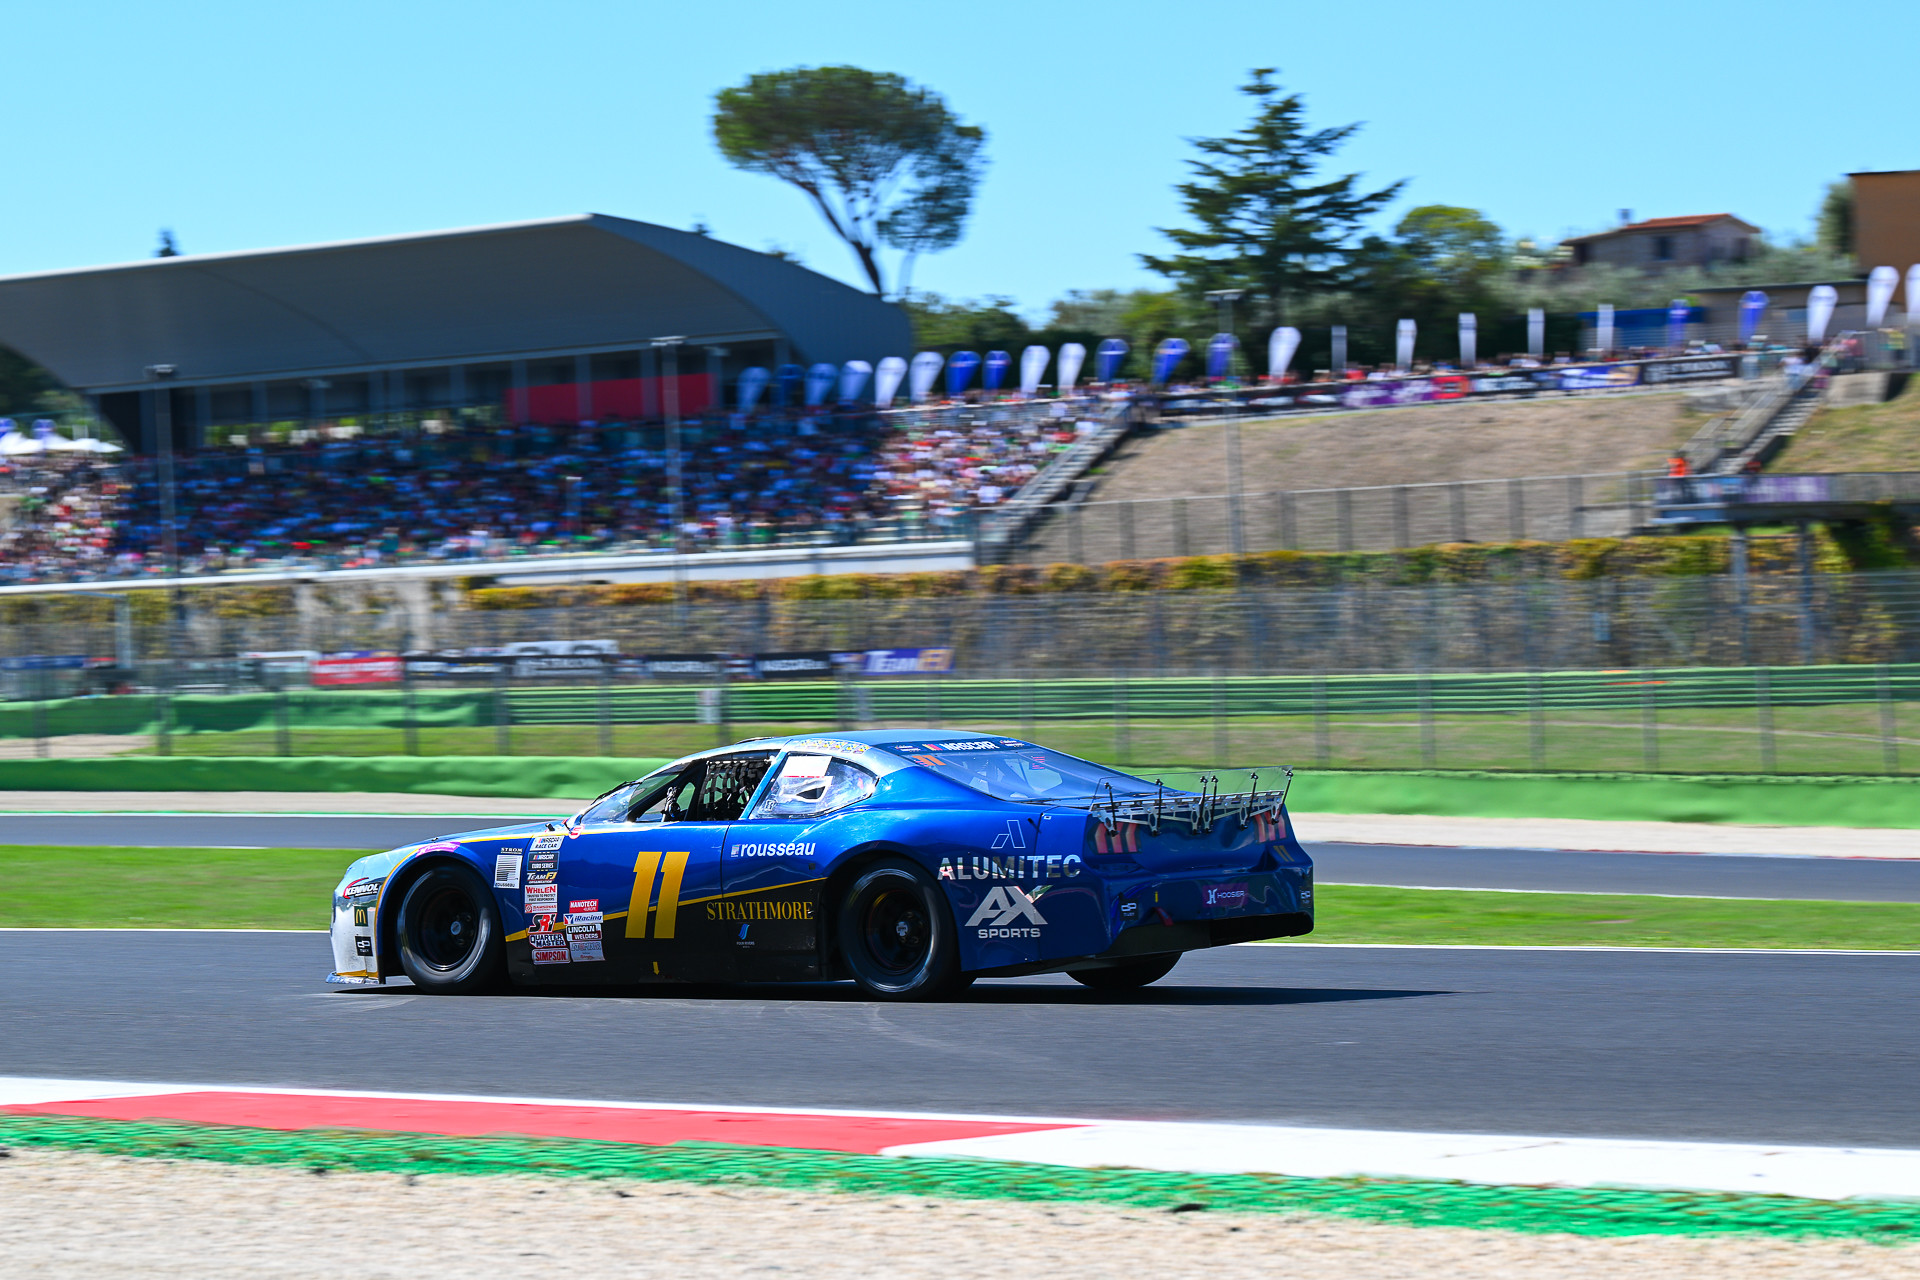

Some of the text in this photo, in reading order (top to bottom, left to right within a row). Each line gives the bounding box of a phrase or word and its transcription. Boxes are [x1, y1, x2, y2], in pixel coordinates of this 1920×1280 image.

[741, 843, 816, 857] rousseau
[937, 854, 1081, 880] ALUMITEC
[525, 885, 556, 894] WHELEN
[625, 852, 690, 939] 11
[706, 902, 814, 920] STRATHMORE
[568, 925, 595, 934] LINCOLN
[978, 928, 1041, 939] SPORTS
[531, 934, 562, 943] QUARTER
[535, 951, 567, 961] SIMPSON
